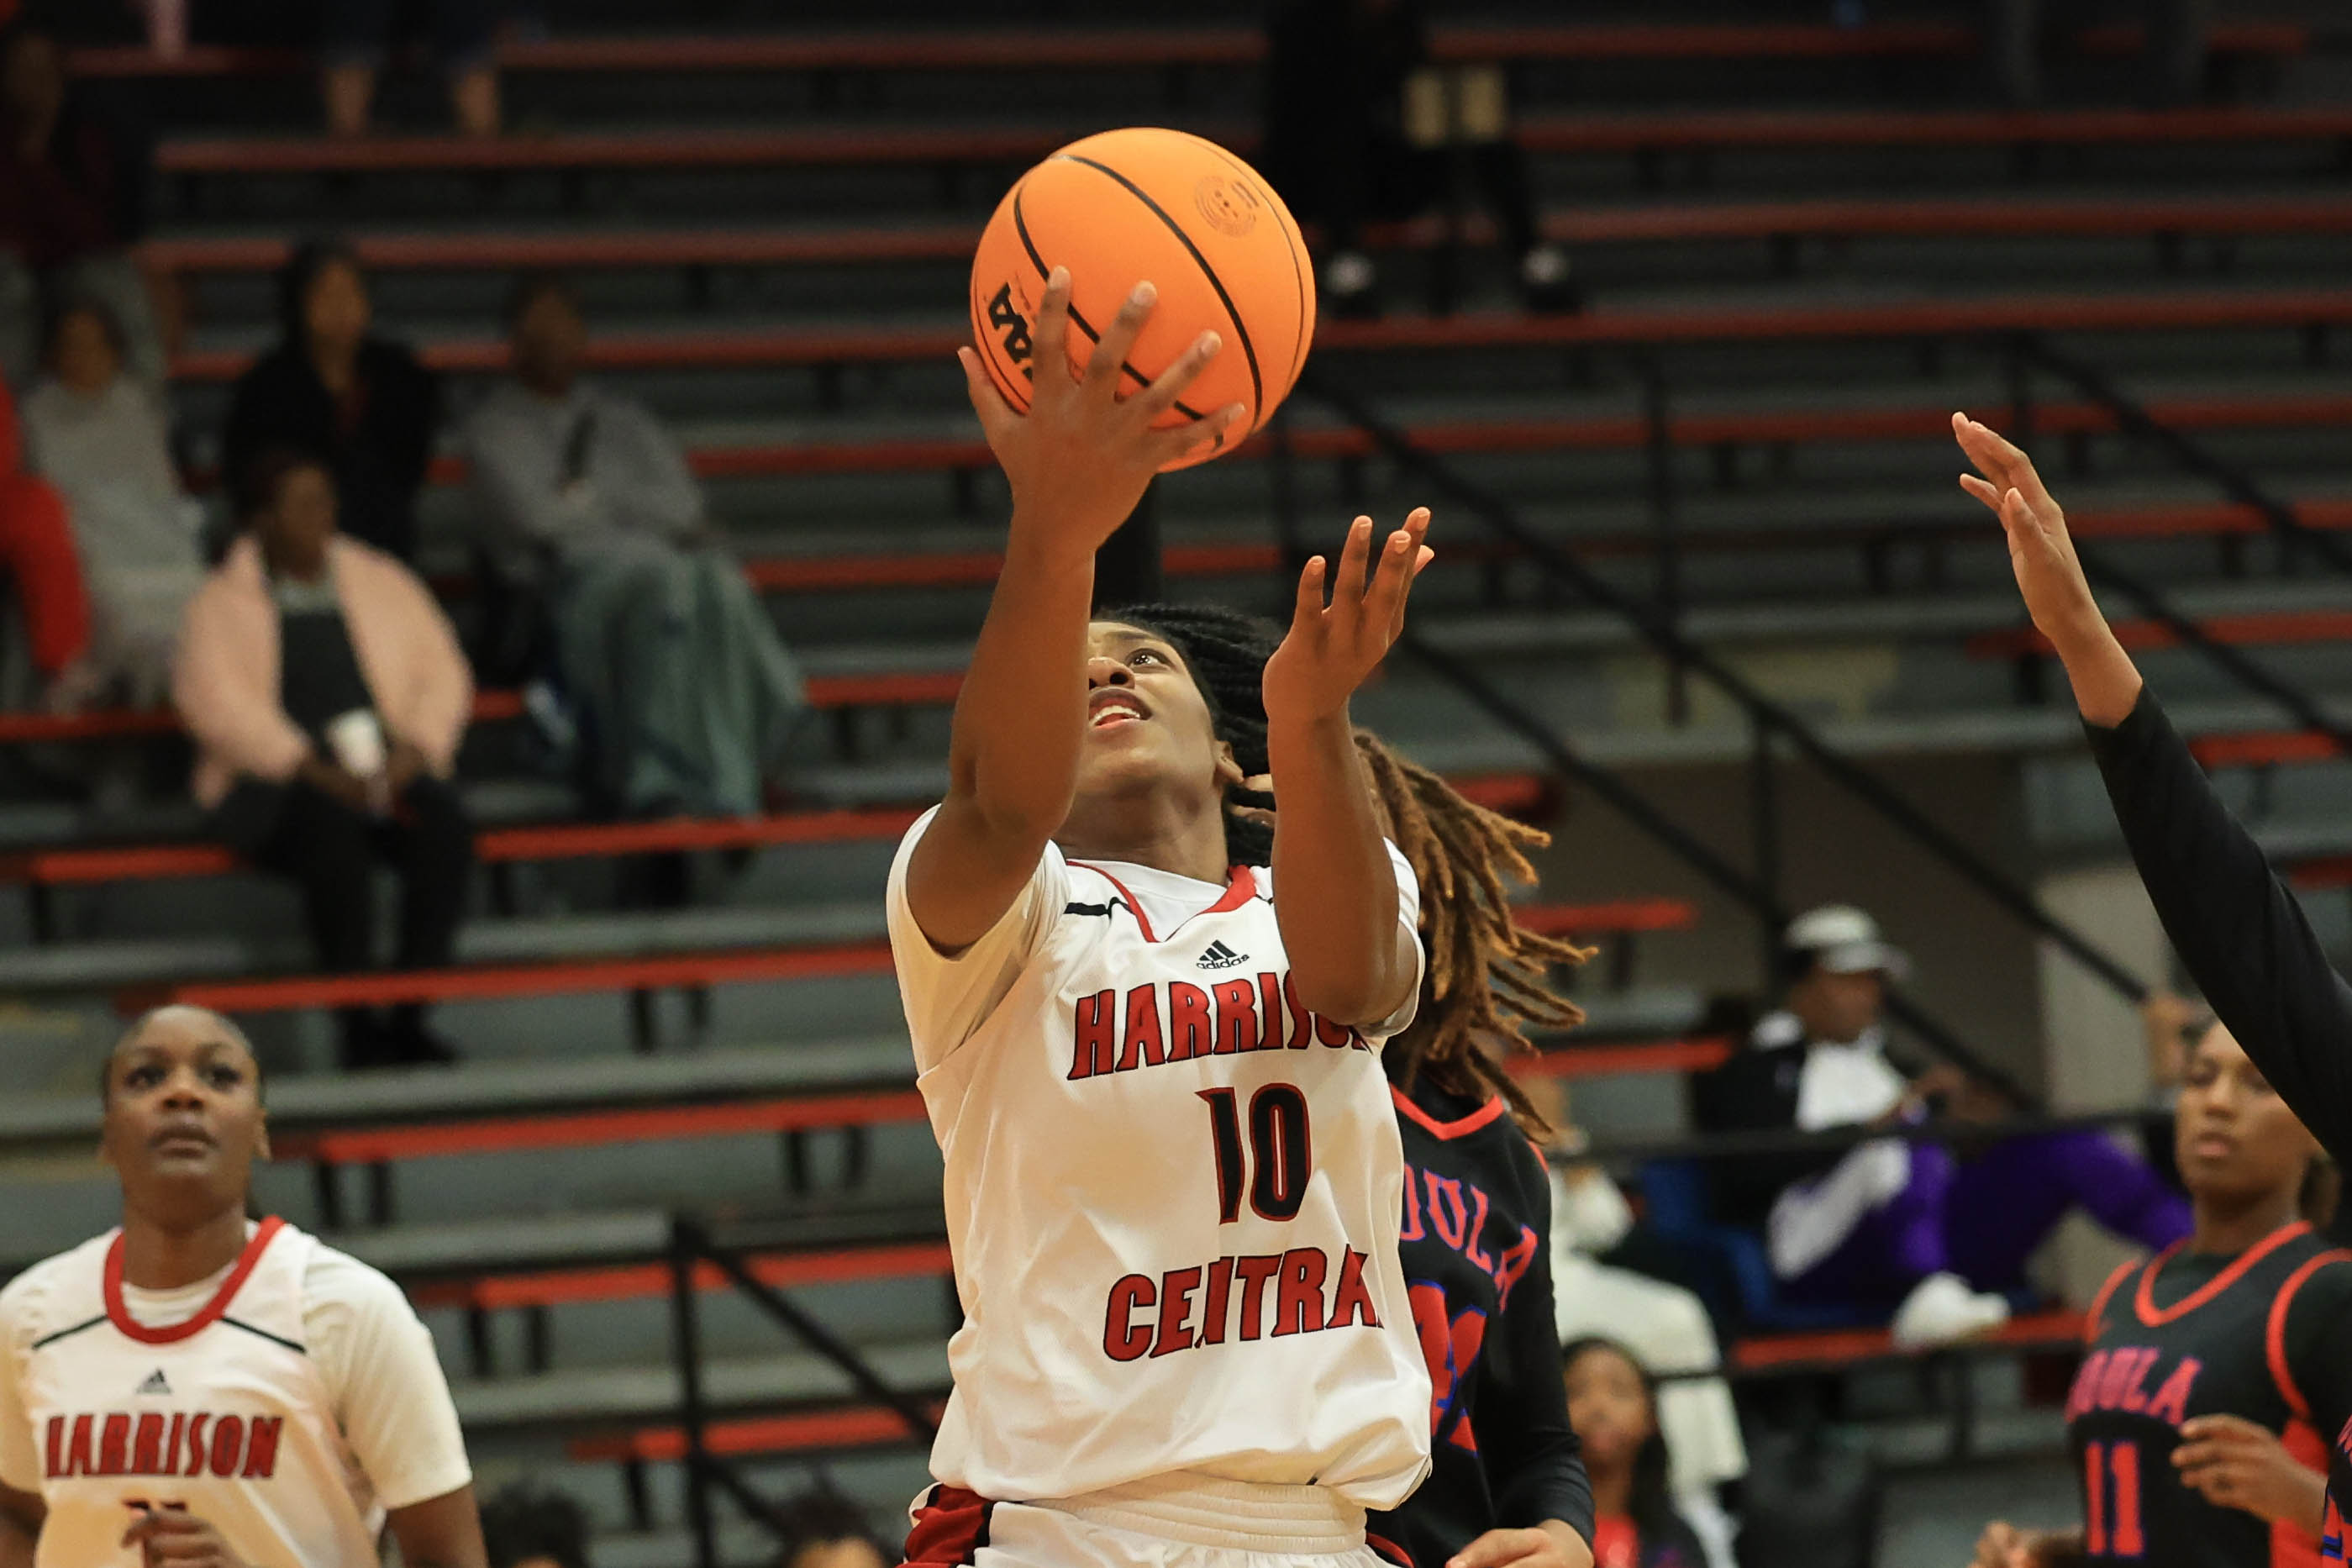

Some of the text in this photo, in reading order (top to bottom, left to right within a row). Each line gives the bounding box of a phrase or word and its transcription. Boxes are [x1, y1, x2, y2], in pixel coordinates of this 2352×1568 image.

[1196, 954, 1250, 971] adidas
[1067, 969, 1374, 1081] HARRIS
[1194, 1082, 1313, 1225] 10
[2085, 1440, 2144, 1557] 11
